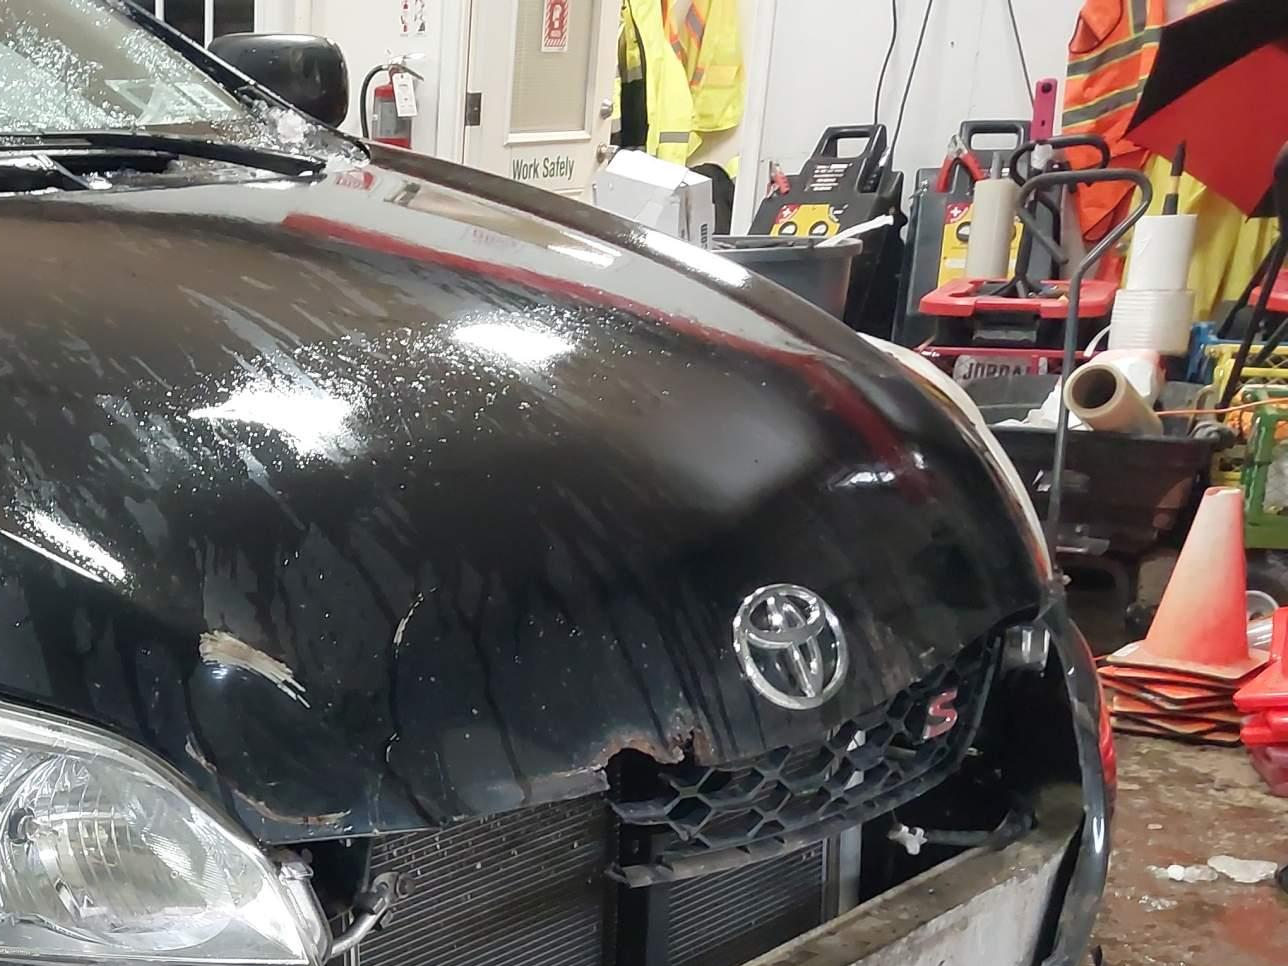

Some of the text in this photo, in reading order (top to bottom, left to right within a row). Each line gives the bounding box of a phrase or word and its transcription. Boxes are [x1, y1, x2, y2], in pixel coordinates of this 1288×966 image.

[512, 155, 575, 181] Work Safely
[962, 362, 1034, 380] JORDA
[921, 688, 959, 740] S
